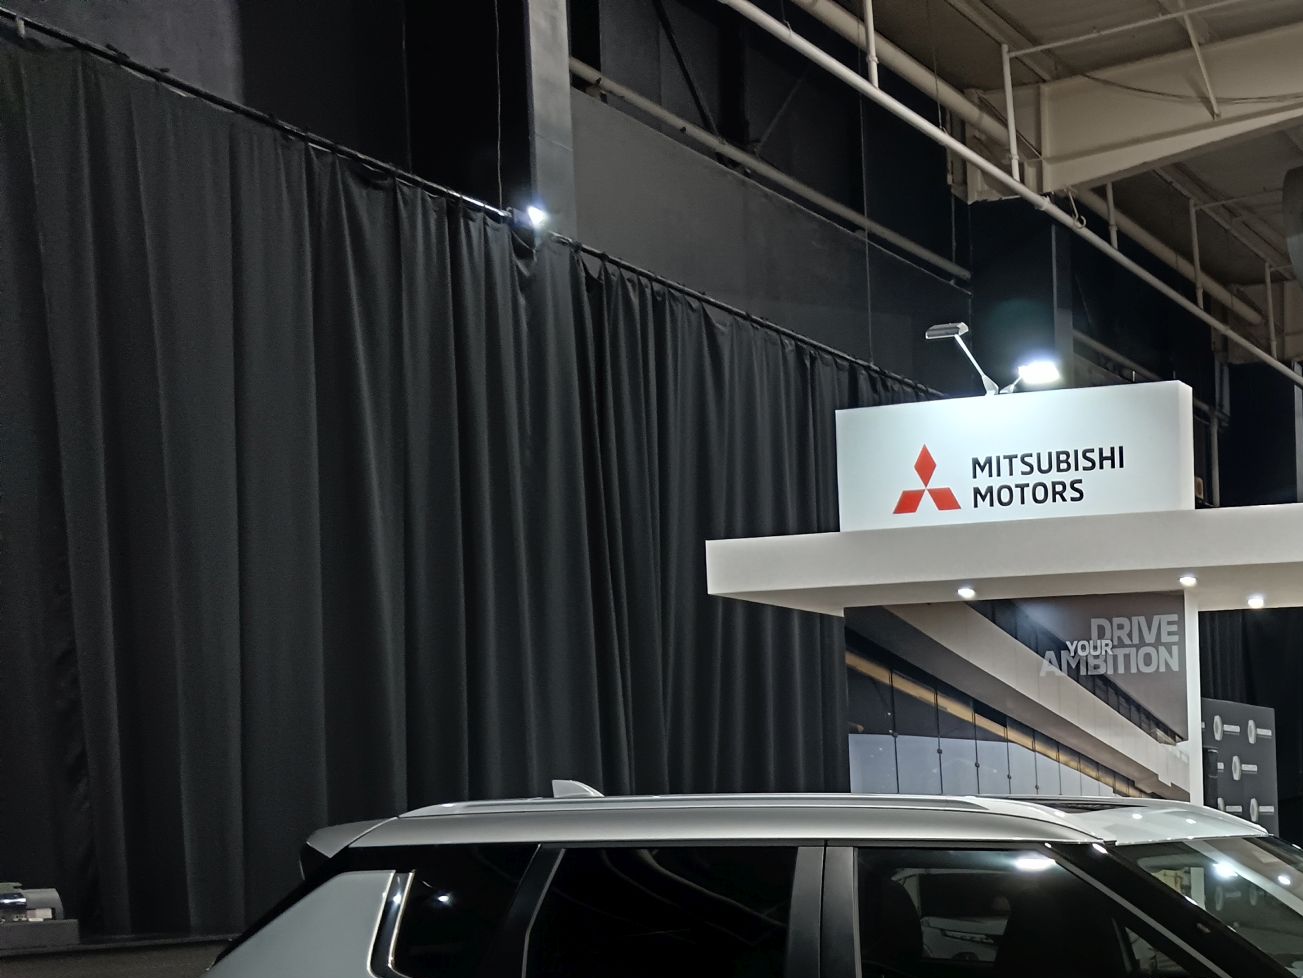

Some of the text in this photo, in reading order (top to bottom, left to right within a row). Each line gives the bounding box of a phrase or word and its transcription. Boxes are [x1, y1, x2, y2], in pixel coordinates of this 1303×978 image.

[971, 445, 1125, 479] MITSUBISHI
[972, 479, 1084, 508] MOTORS
[1090, 613, 1179, 645] DRIVE
[1039, 645, 1179, 677] AMBITION
[1065, 639, 1113, 657] YOUR
